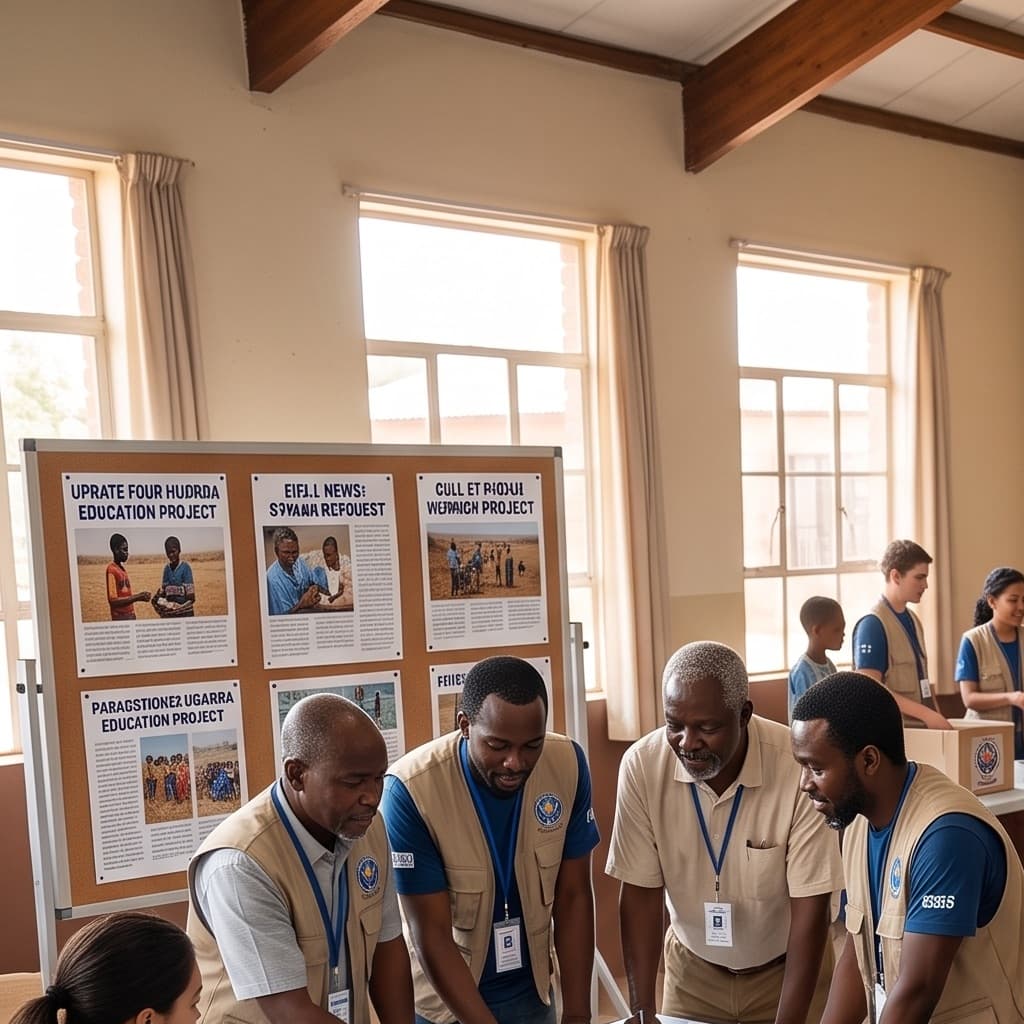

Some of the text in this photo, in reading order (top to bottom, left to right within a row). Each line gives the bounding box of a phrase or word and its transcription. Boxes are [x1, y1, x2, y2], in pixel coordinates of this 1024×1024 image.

[71, 484, 124, 499] UPRATE
[128, 484, 162, 499] FOUR
[435, 482, 464, 496] CULL
[467, 482, 480, 496] ET
[78, 504, 216, 520] EDUCATION PROJECT
[482, 501, 534, 515] PROJECT
[102, 709, 224, 733] EDUCATION PROJECT
